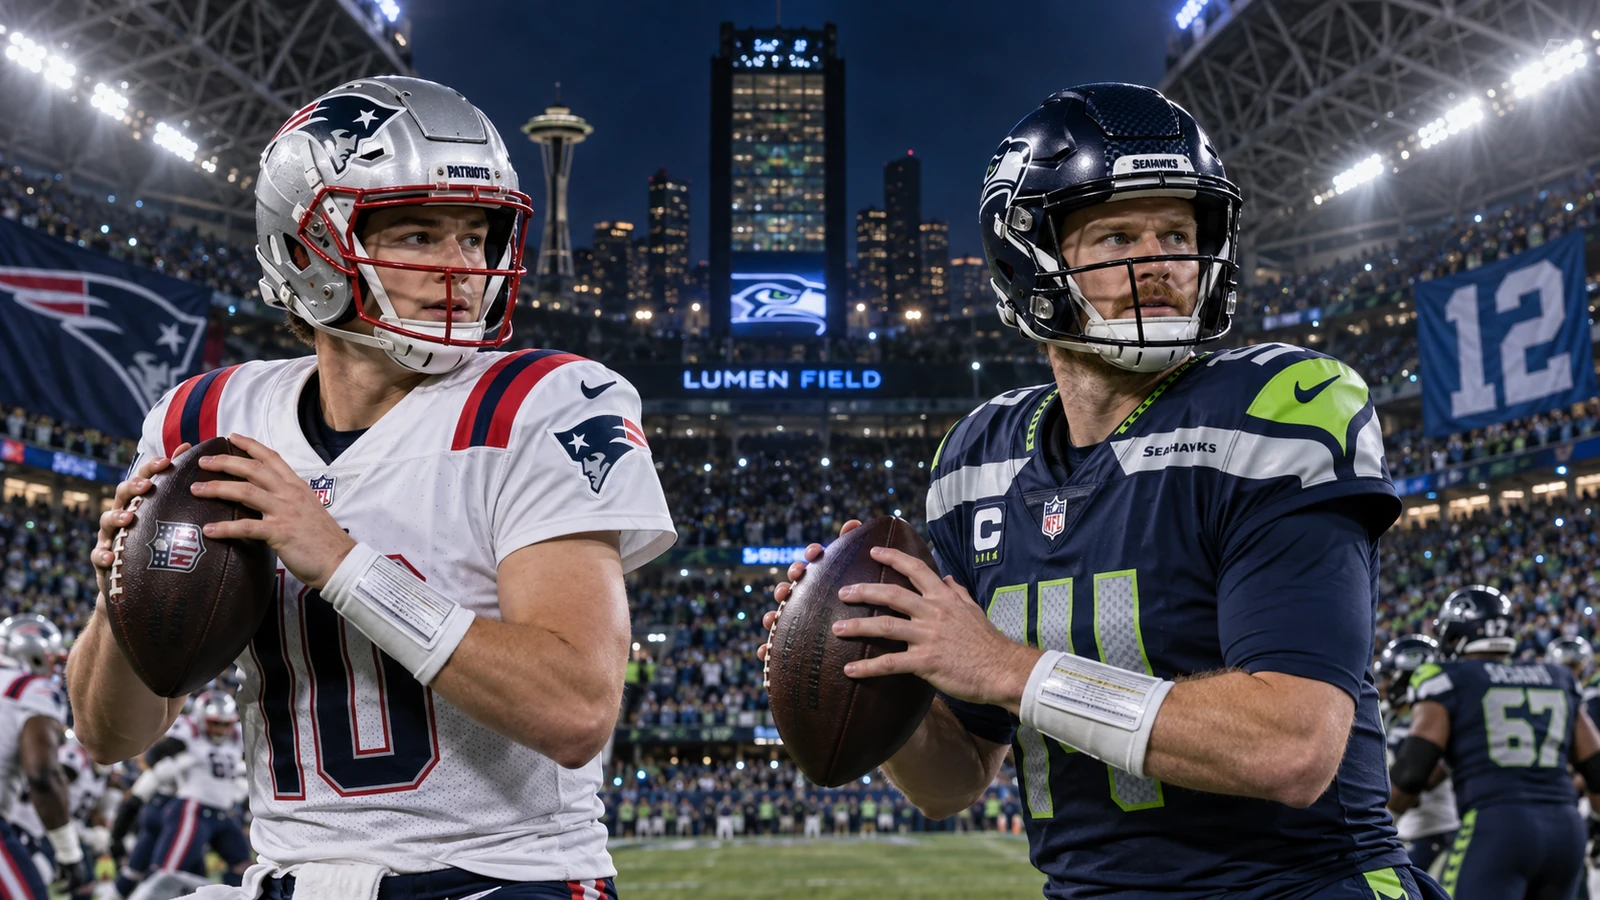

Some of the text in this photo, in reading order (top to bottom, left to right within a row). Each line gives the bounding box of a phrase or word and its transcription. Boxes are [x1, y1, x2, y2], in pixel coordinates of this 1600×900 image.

[447, 165, 490, 180] PATRIOTS
[1132, 159, 1178, 169] SEAHAWKS
[1445, 259, 1573, 418] 12
[683, 370, 881, 389] LUMEN FIELD
[974, 507, 1002, 551] C
[1045, 514, 1061, 533] NFL
[247, 553, 440, 800] 10
[987, 569, 1165, 819] 14
[1482, 687, 1567, 767] 67
